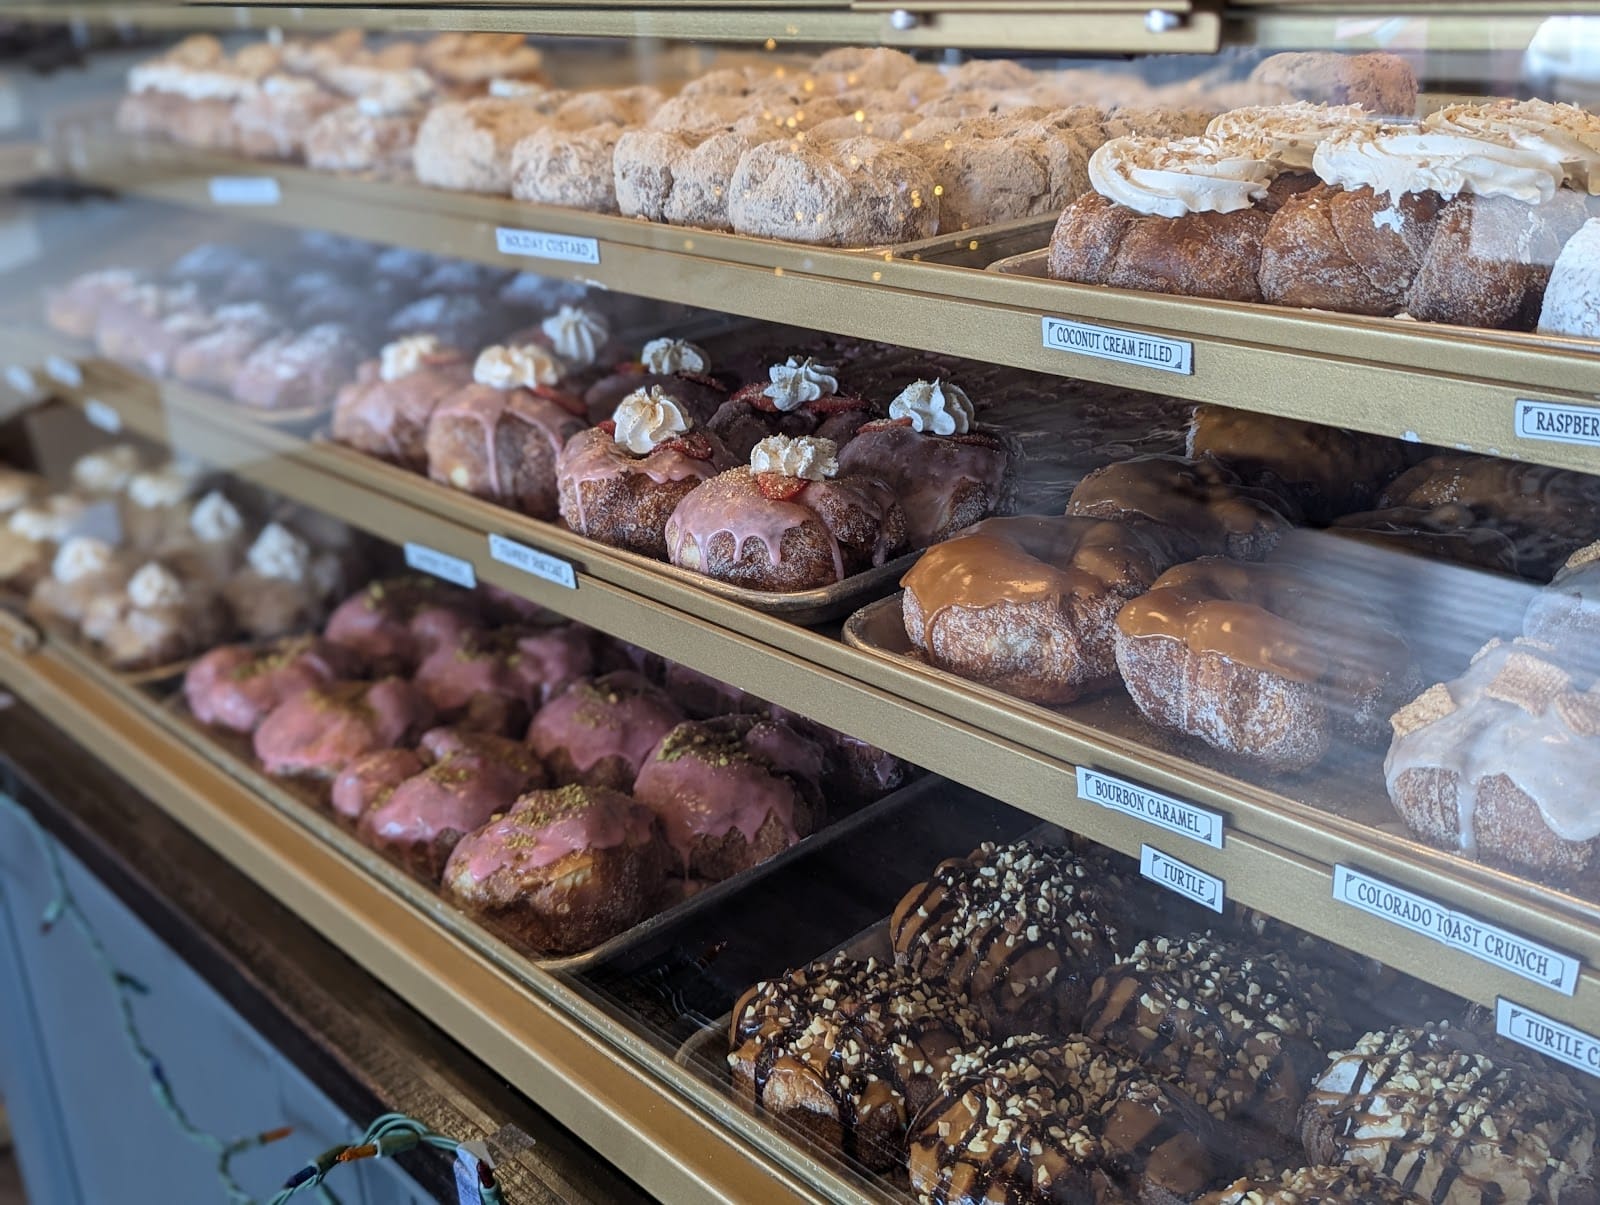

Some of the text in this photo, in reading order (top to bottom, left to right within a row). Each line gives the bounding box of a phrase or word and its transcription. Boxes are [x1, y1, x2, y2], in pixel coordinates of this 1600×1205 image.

[545, 238, 590, 256] CUSTARD
[1056, 327, 1172, 363] COCONUT CREAM FILLED
[1536, 411, 1600, 437] RASPBER
[1095, 779, 1201, 833] BOURBON CARAMEL
[1162, 862, 1206, 897] TURTLE
[1358, 883, 1550, 977] COLORADO TOAST CRUNCH
[1525, 1018, 1600, 1069] TURTLE C
